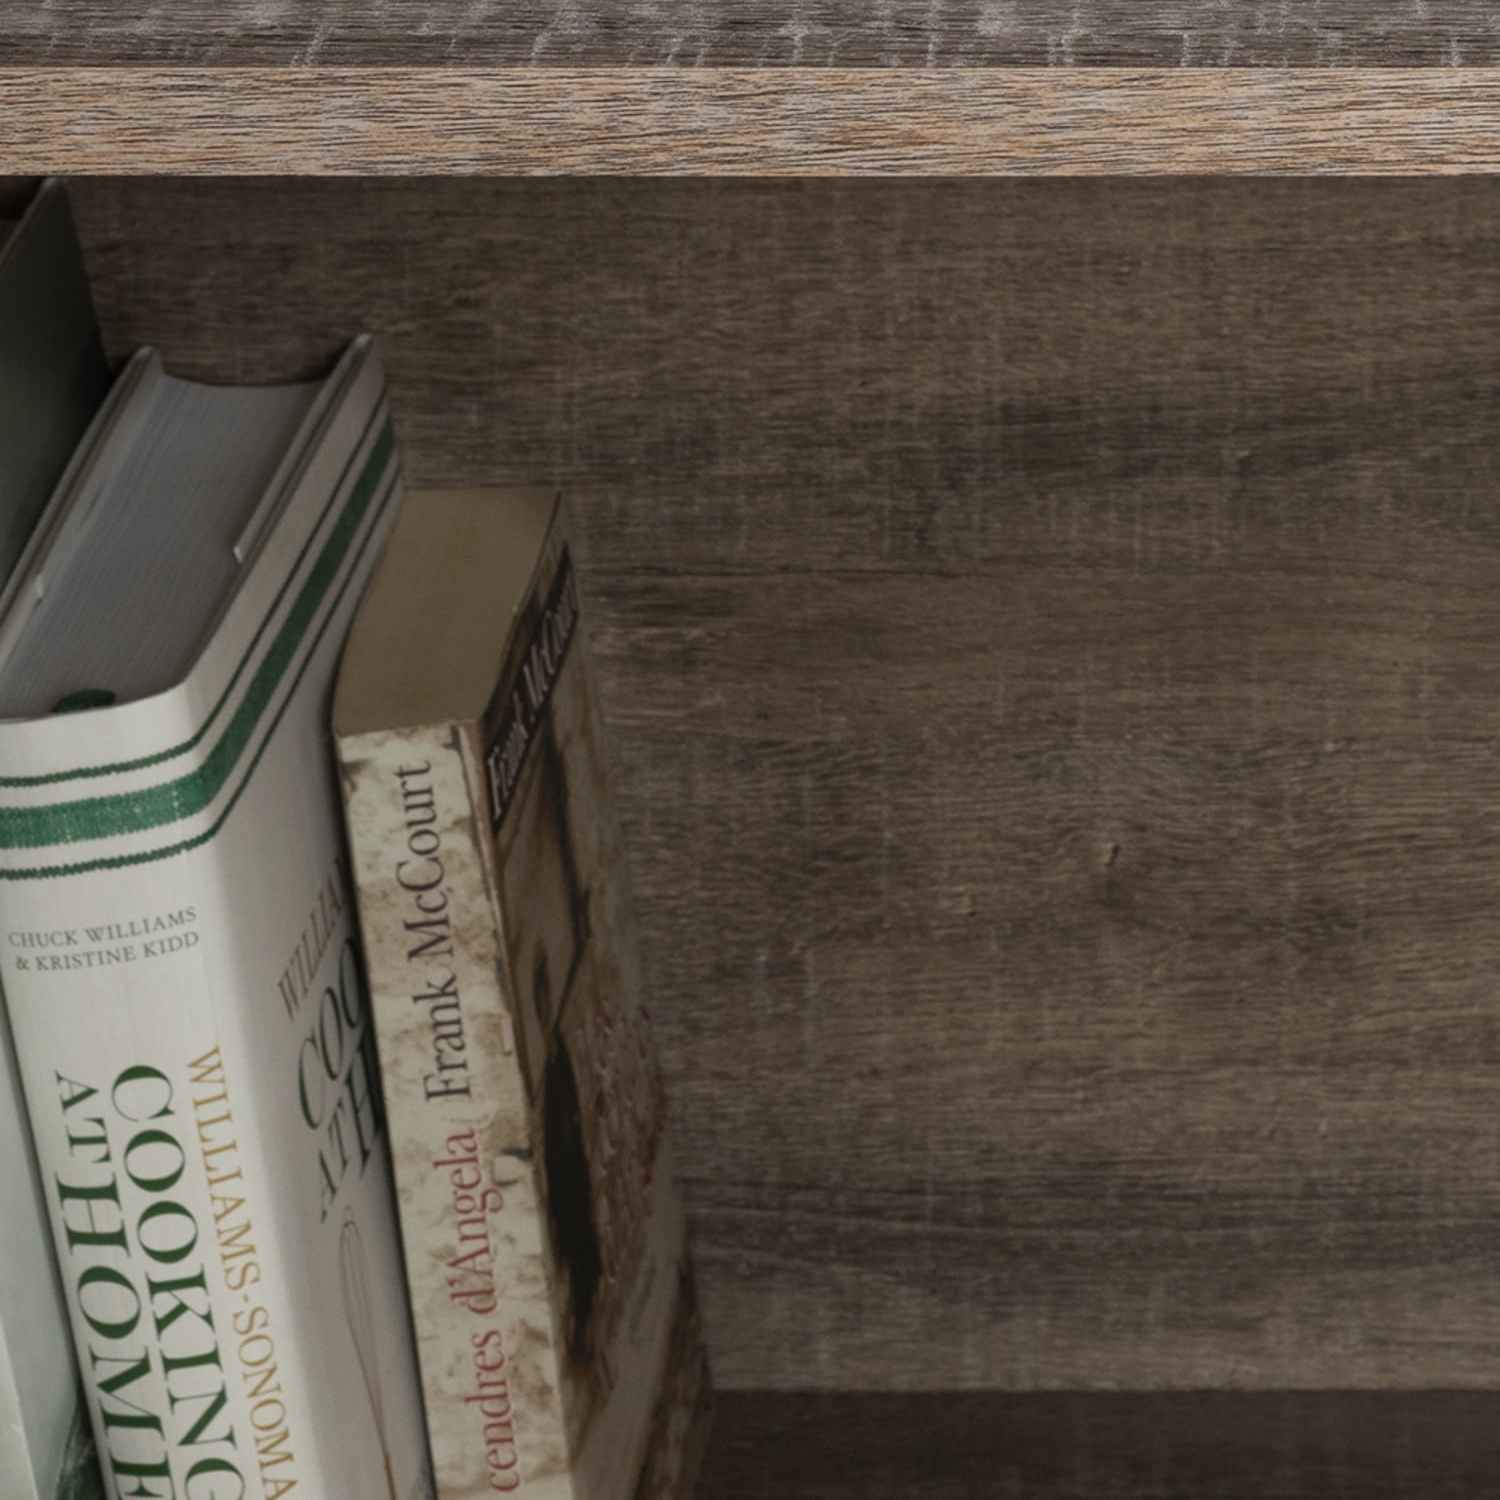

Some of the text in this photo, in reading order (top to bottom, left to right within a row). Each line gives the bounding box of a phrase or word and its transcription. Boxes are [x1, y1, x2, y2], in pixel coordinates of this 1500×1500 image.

[8, 906, 197, 948] CHUCK WILLIAMS
[15, 931, 200, 972] & KRISTINE KIDD
[391, 761, 470, 1101] Frank McCourt
[110, 1064, 246, 1499] COOKING
[433, 1128, 520, 1493] cendres d'Angela
